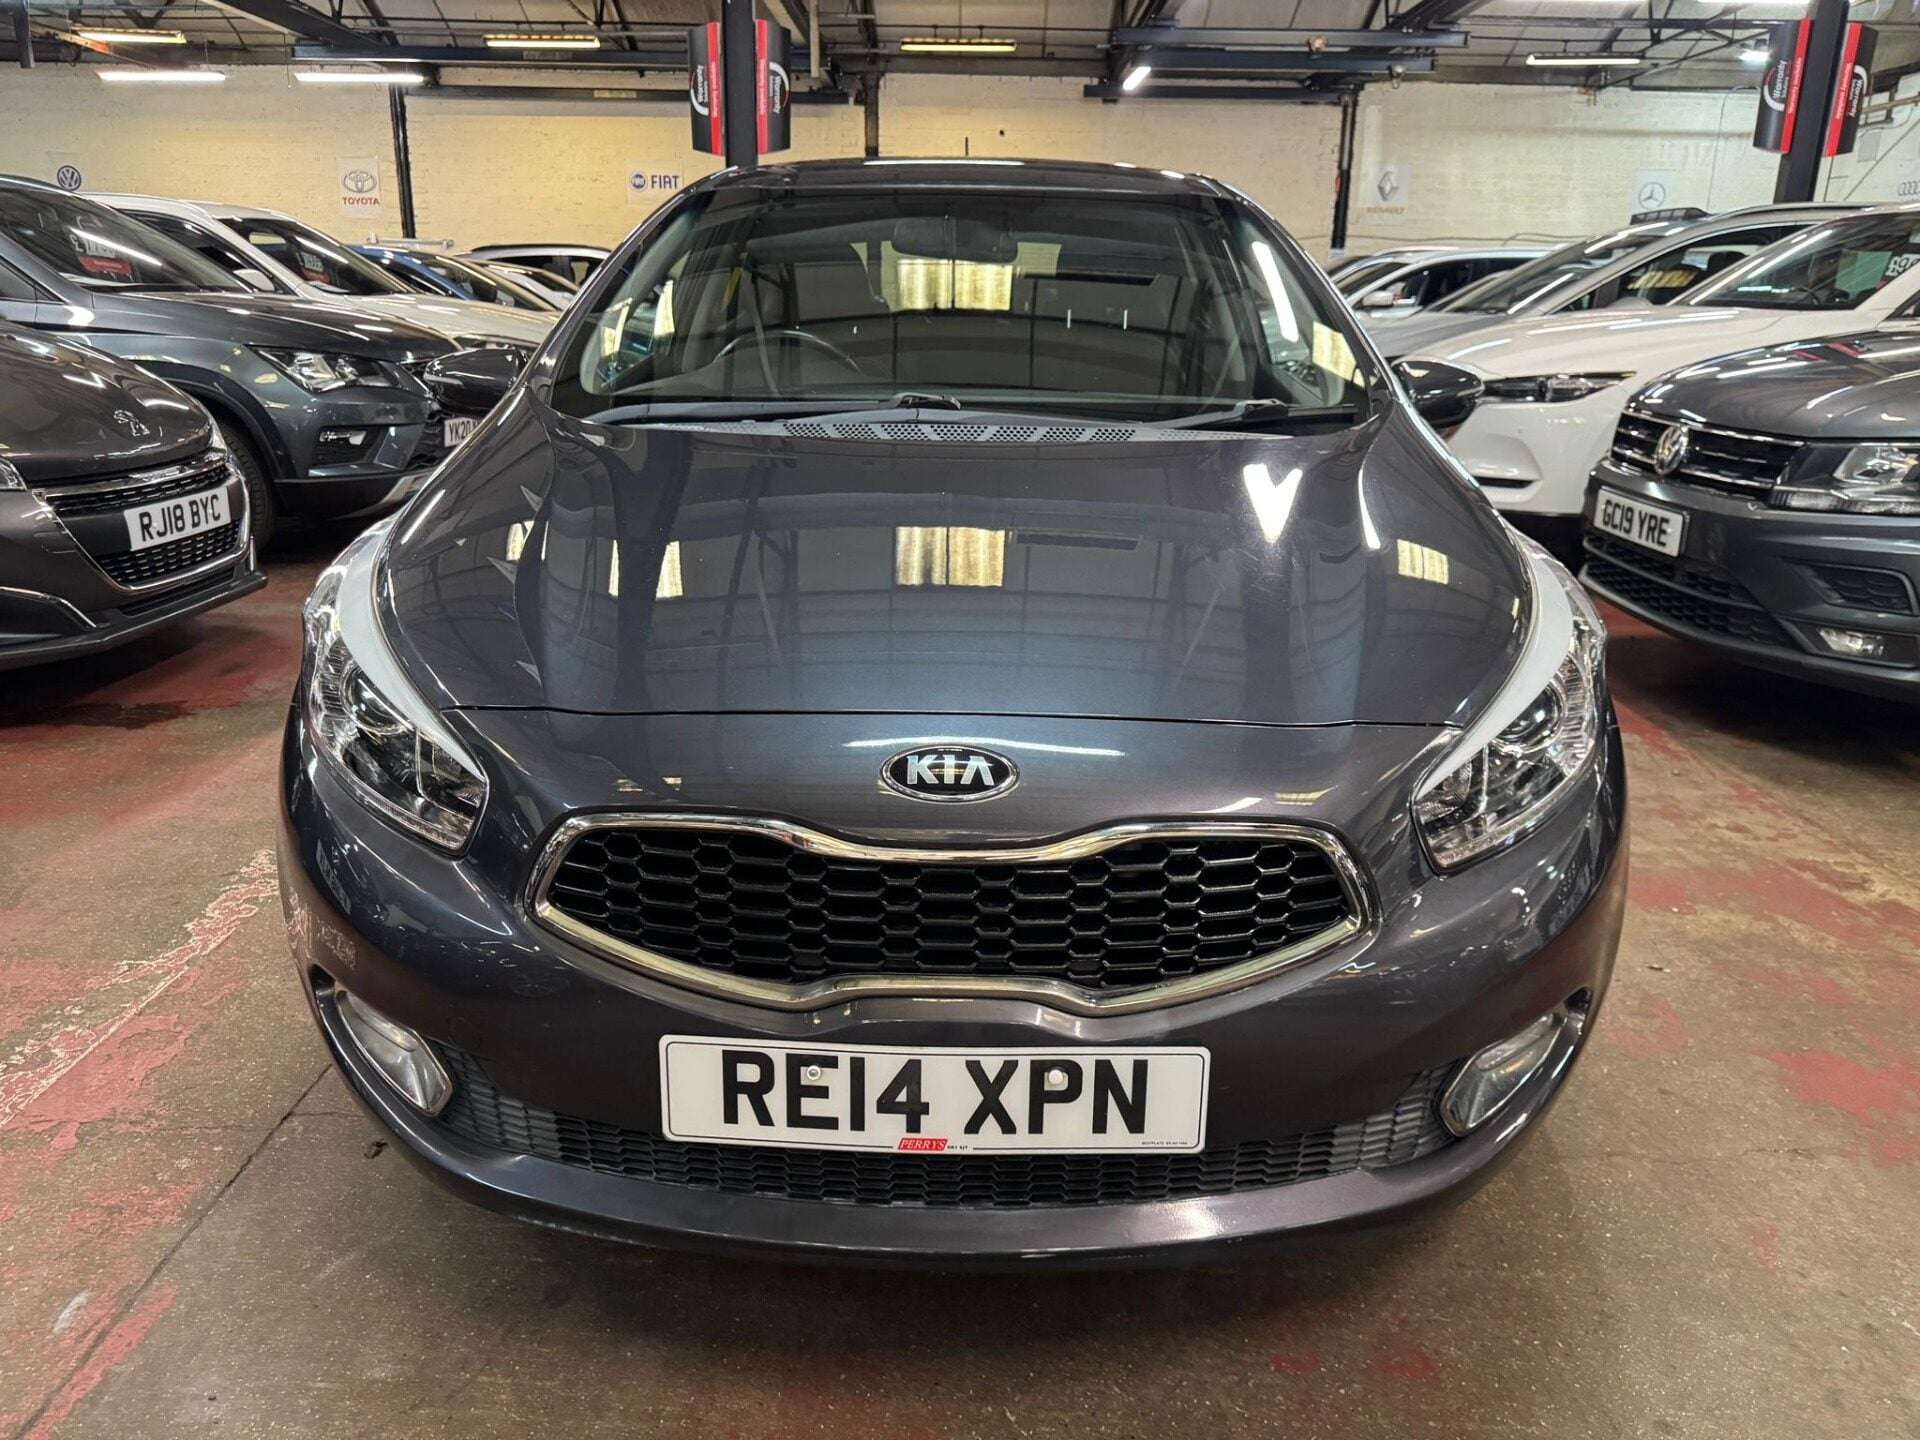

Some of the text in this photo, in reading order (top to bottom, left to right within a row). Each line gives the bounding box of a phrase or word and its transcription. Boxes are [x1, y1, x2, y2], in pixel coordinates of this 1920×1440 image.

[1772, 60, 1787, 99] Warranty
[1848, 79, 1863, 117] Warranty
[651, 175, 679, 189] FIAT
[342, 197, 380, 205] TOYOTA
[449, 420, 471, 442] YK20
[139, 494, 221, 542] RJ18 BYC
[1602, 499, 1670, 547] GC19 YRE
[906, 754, 995, 786] KIA
[722, 1049, 1148, 1135] RE14 XPN
[899, 1139, 946, 1150] PERRYS
